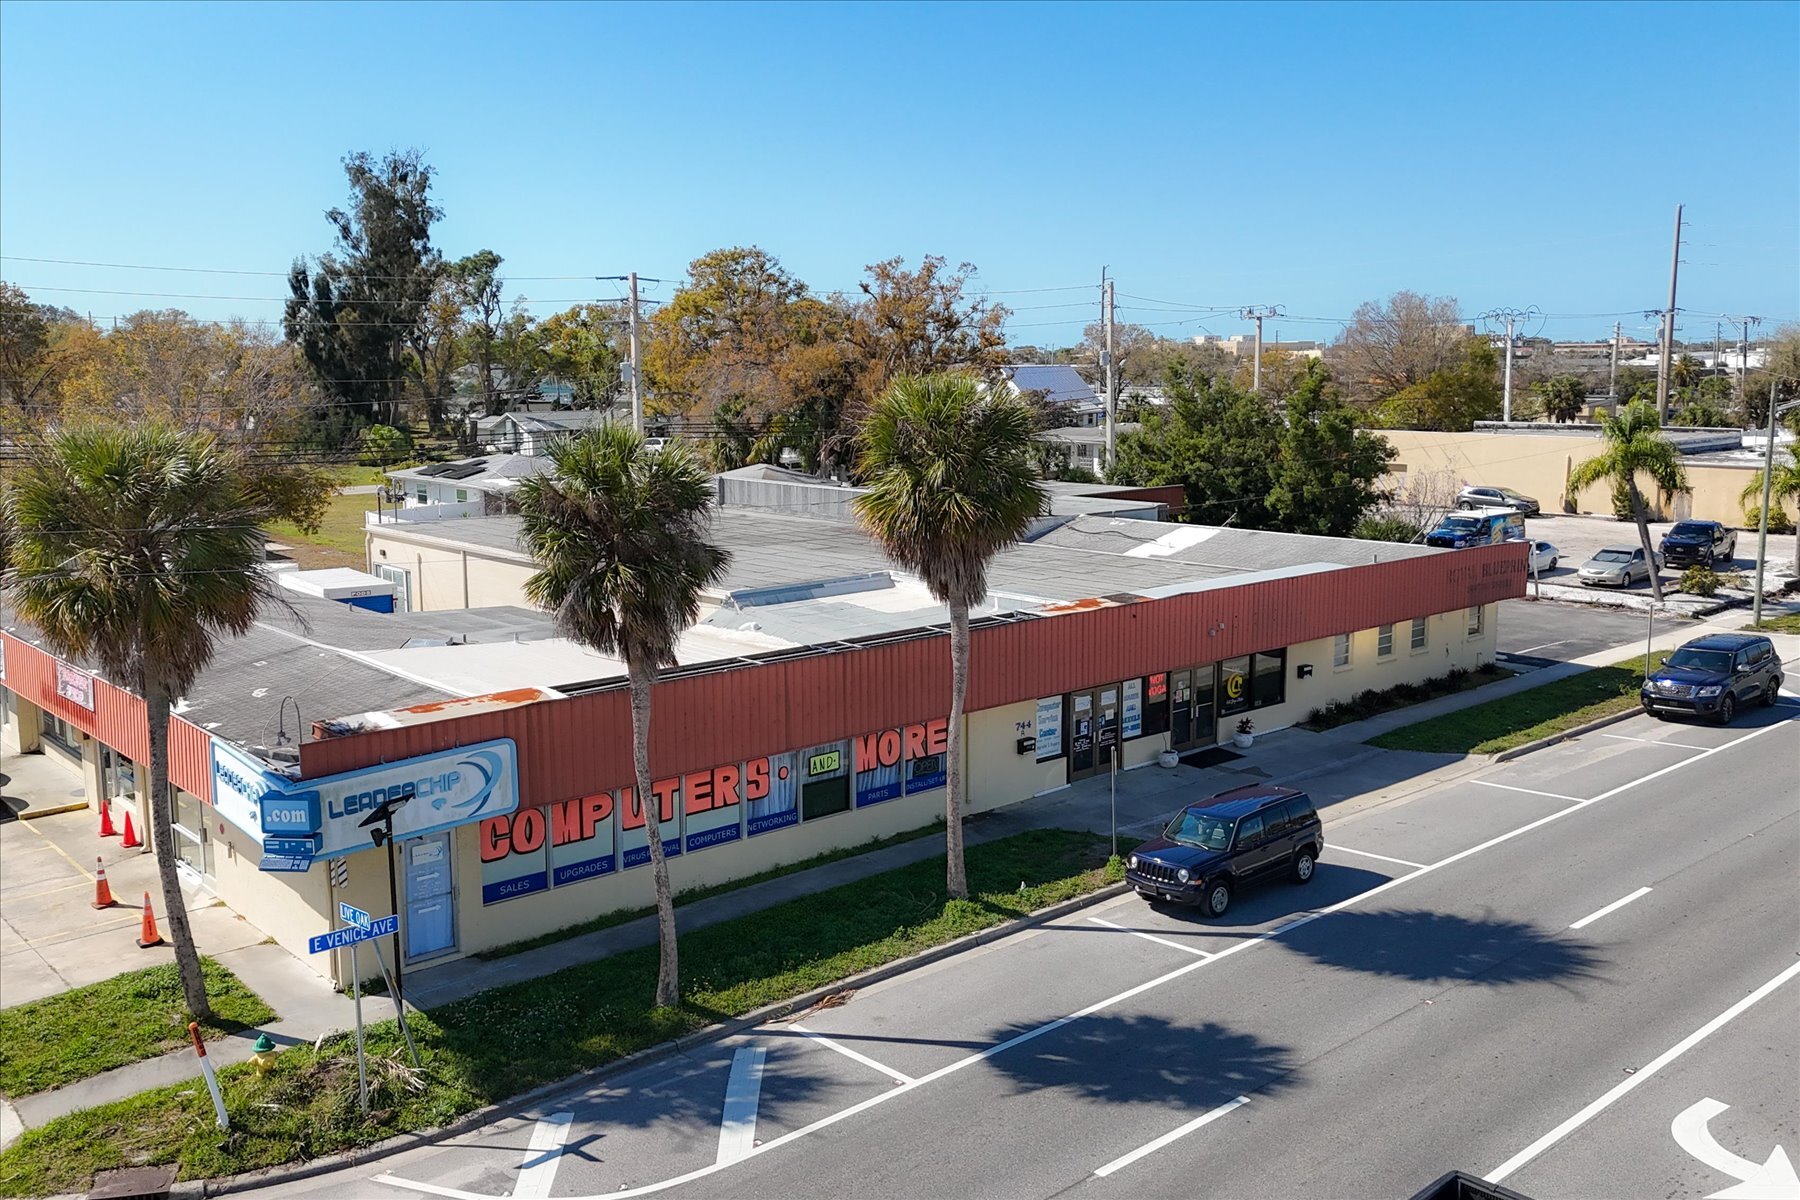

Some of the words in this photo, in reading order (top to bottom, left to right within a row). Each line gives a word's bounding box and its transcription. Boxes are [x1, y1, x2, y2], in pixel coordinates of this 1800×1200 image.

[1015, 720, 1031, 731] 744
[329, 769, 462, 820] LEADERCHIP
[480, 756, 770, 863] COMPUTERS
[855, 717, 948, 775] MORE
[868, 789, 889, 800] PARTS
[266, 808, 306, 823] .com
[747, 812, 798, 832] NETWORKING
[689, 827, 737, 847] COMPUTERS
[623, 851, 646, 863] VIRUS
[560, 860, 608, 880] UPGRADES
[500, 880, 530, 895] SALES
[355, 909, 369, 929] OAK
[314, 938, 322, 952] E
[326, 927, 368, 948] VENICE
[372, 918, 394, 936] AVE
